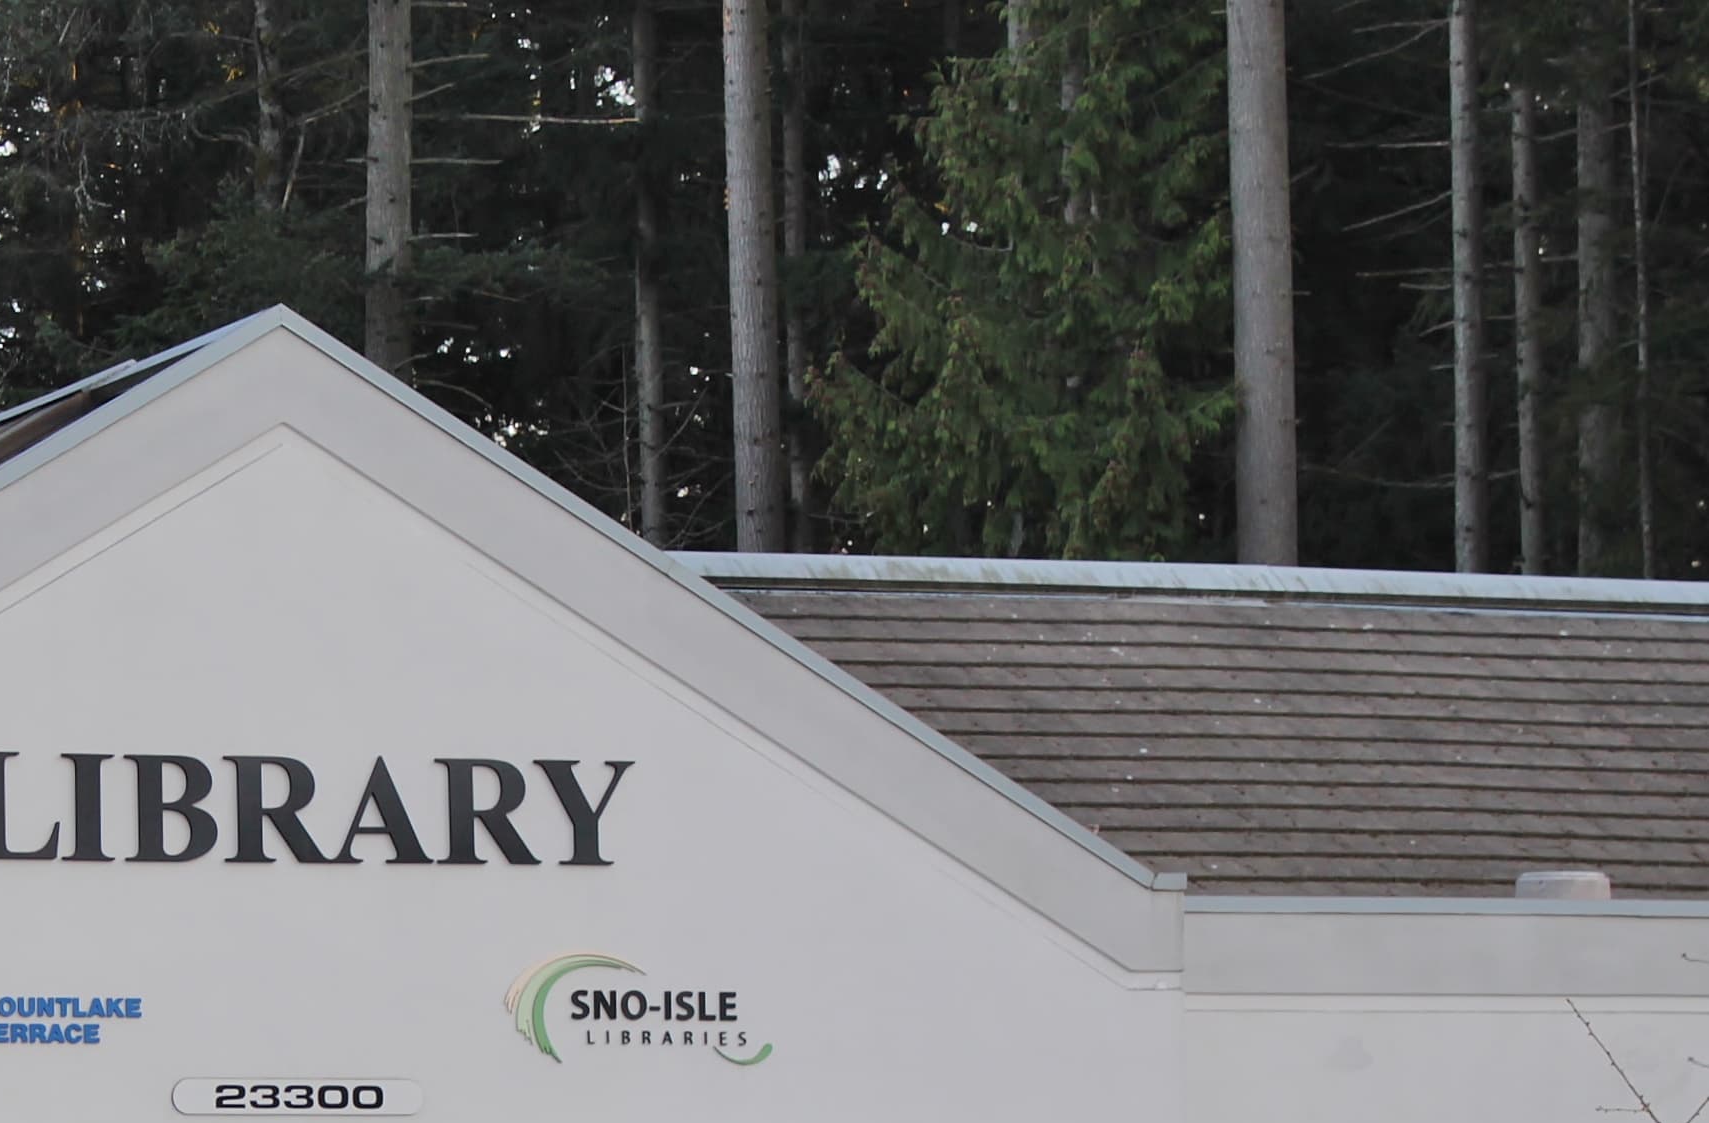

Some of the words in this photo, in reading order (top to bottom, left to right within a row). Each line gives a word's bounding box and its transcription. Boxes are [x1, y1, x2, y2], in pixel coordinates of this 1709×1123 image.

[569, 988, 738, 1022] SNO-ISLE
[586, 1029, 749, 1047] LIBRARIES
[214, 1083, 384, 1111] 23300
